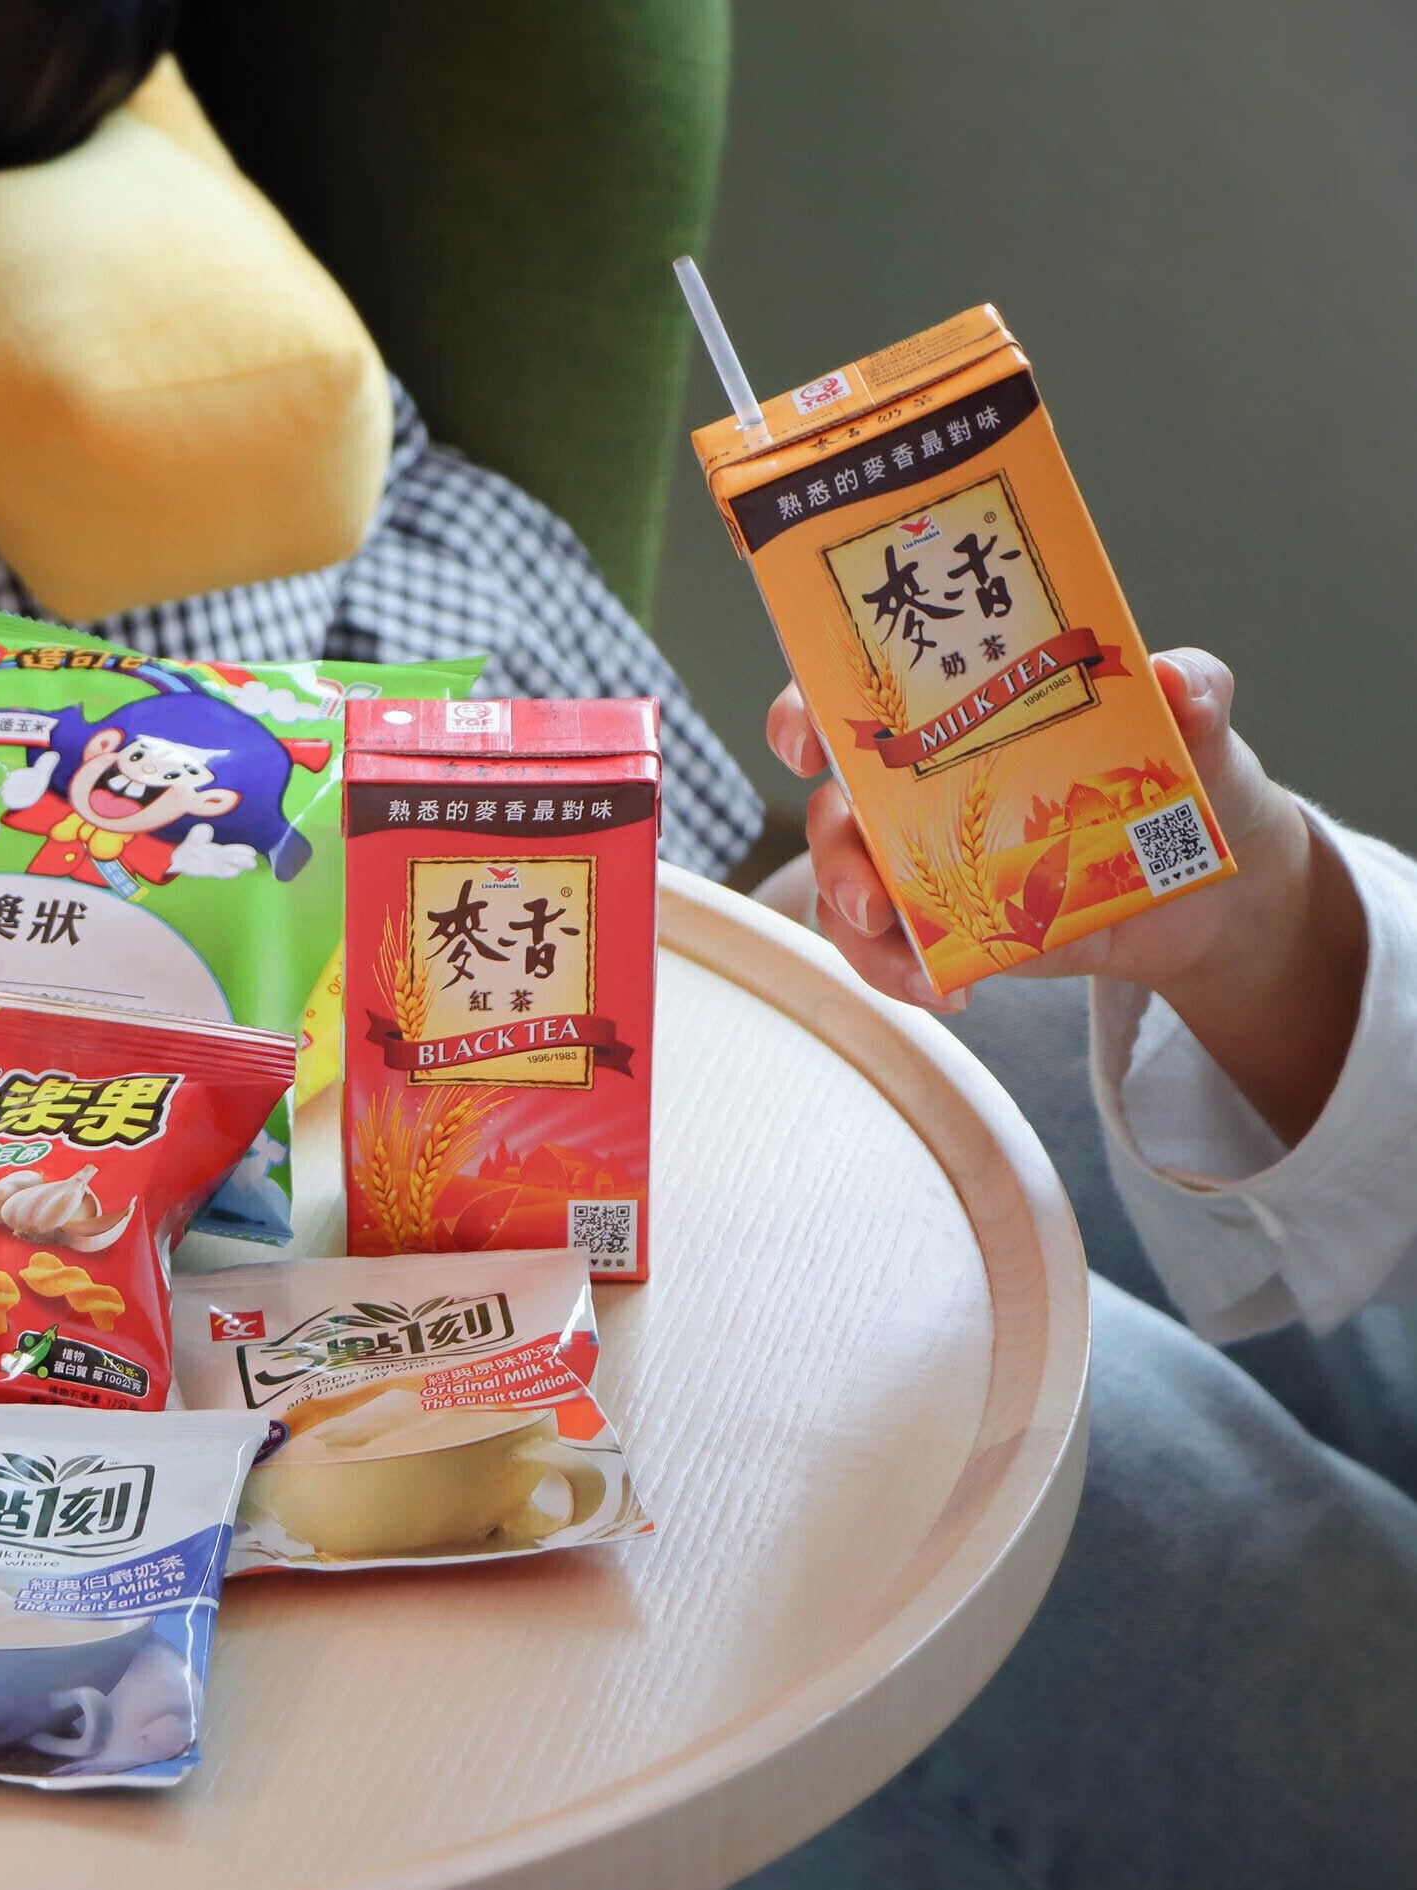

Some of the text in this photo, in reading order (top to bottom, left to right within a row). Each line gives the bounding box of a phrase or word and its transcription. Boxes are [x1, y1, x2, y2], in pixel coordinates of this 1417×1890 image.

[776, 404, 1002, 522] 熟悉的麥香最對味
[861, 532, 1022, 672] 麥香
[940, 634, 1007, 681] 奶茶
[919, 649, 1059, 752] MILK TEA
[387, 800, 614, 822] 熟悉的麥香最對味
[425, 879, 580, 992] 麥香
[468, 988, 534, 1013] 紅茶
[418, 1017, 580, 1066] BLACK TEA
[527, 1051, 578, 1064] 1996/1983
[421, 1376, 501, 1398] Original
[505, 1364, 545, 1386] Milk
[423, 1395, 454, 1411] Thé
[456, 1396, 477, 1406] au
[480, 1391, 507, 1405] lait
[14, 1585, 183, 1613] Thé au lait Earl Grey
[18, 1589, 62, 1601] Earl
[64, 1589, 113, 1602] Grey
[118, 1579, 163, 1597] Milk
